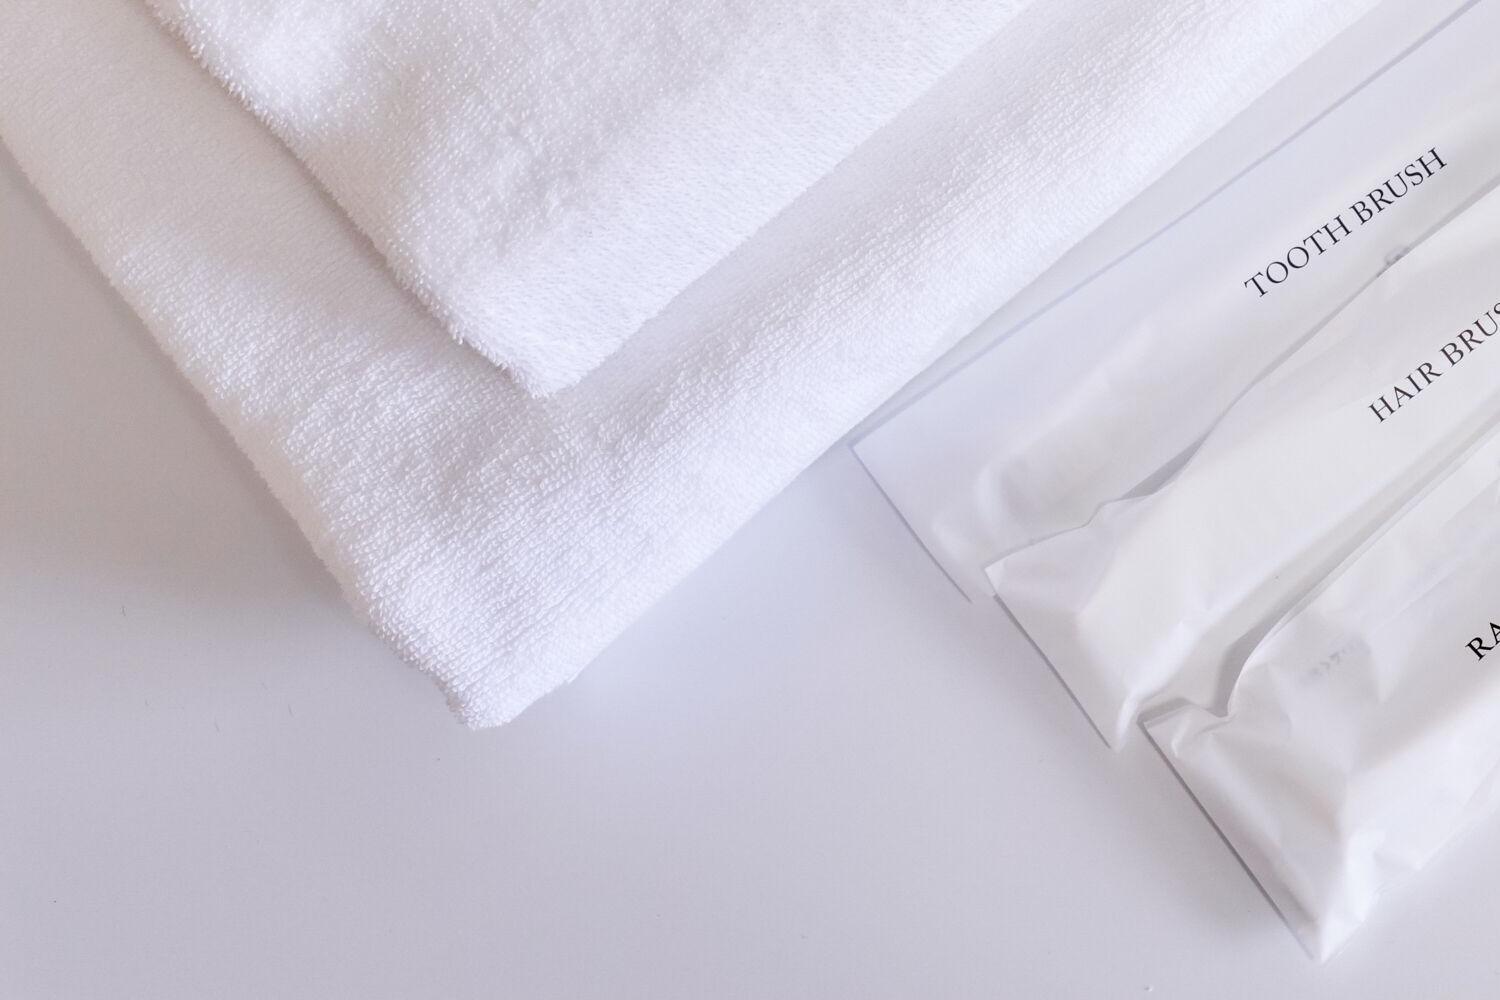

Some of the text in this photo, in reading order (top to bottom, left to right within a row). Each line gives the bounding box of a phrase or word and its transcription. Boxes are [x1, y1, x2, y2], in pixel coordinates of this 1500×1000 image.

[1244, 147, 1448, 298] TOOTH BRUSH
[1368, 362, 1443, 423] HAIR
